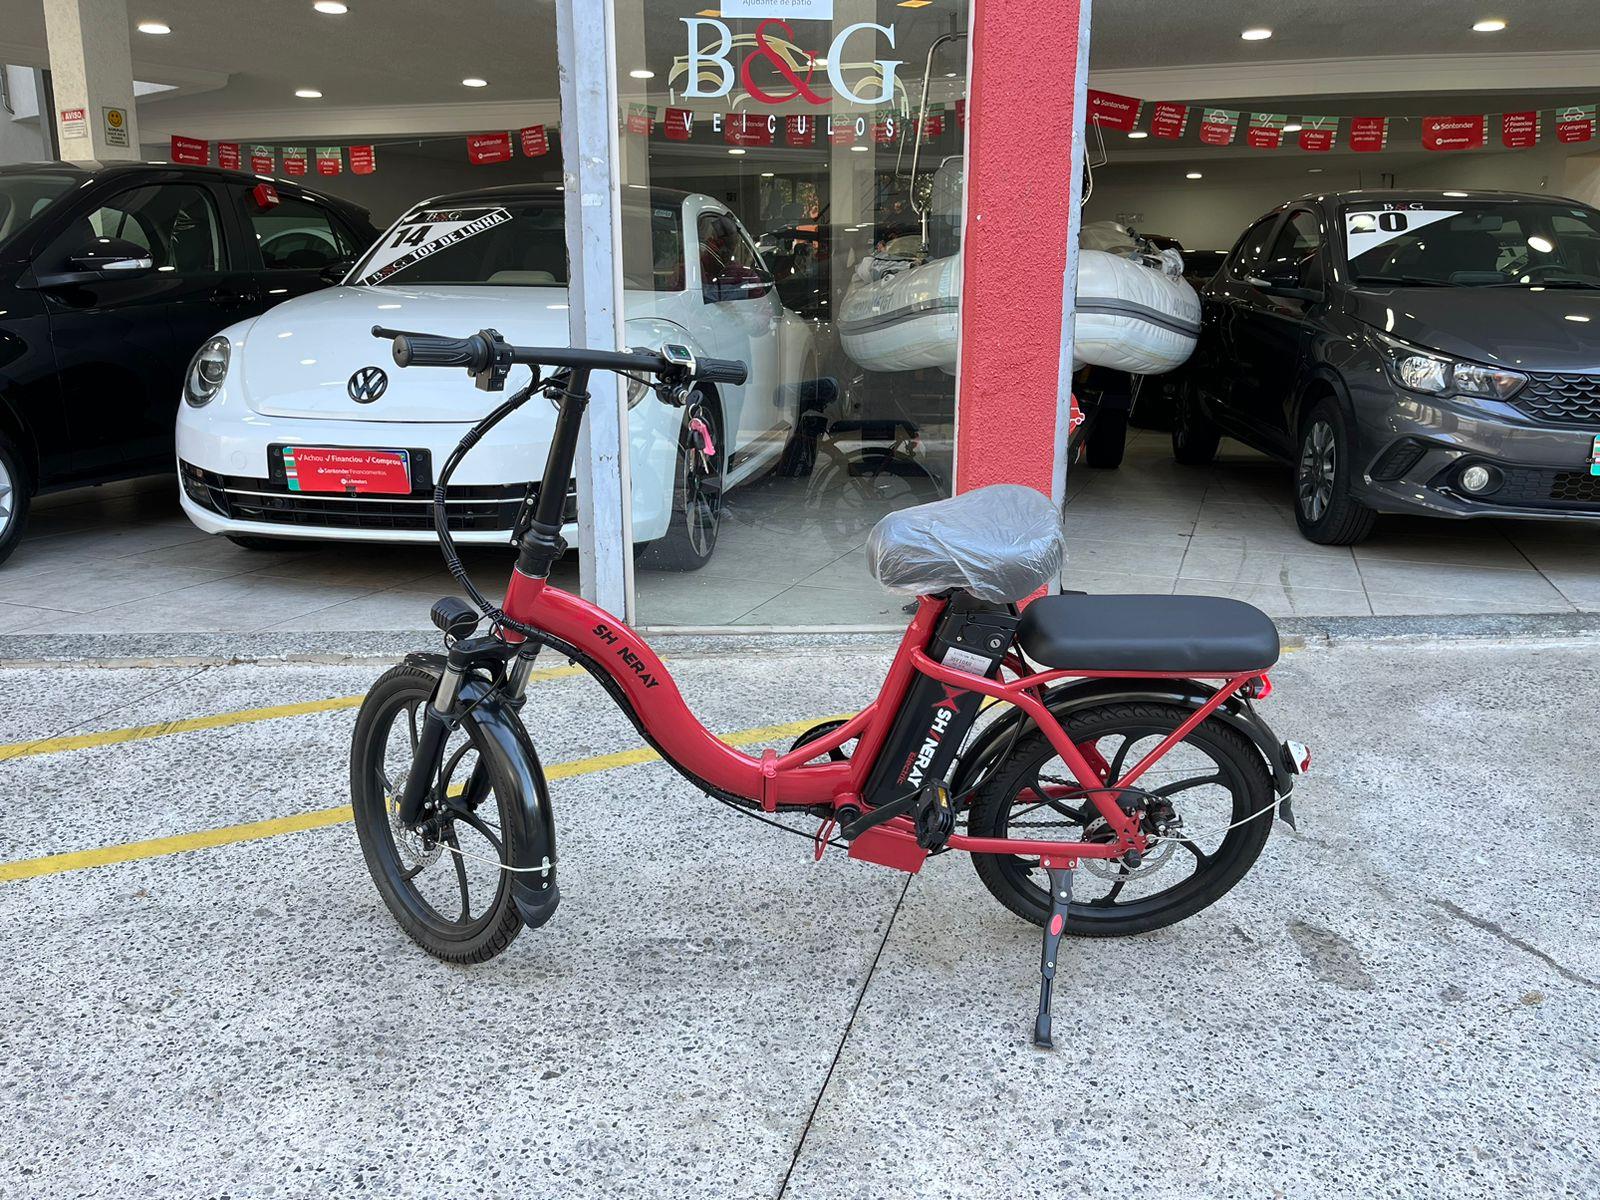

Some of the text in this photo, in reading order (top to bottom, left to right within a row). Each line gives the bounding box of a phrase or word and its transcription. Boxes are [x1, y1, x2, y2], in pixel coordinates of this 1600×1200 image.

[679, 18, 903, 105] B&G
[1100, 99, 1130, 110] Santander
[683, 110, 893, 137] VEÍCULOS
[1440, 122, 1474, 130] Santander
[1349, 212, 1408, 234] 20
[390, 225, 434, 248] 14
[410, 242, 438, 261] TOP
[439, 233, 460, 246] DE
[461, 213, 504, 237] LINHA
[332, 455, 363, 463] Financiou
[372, 456, 401, 466] Comprou
